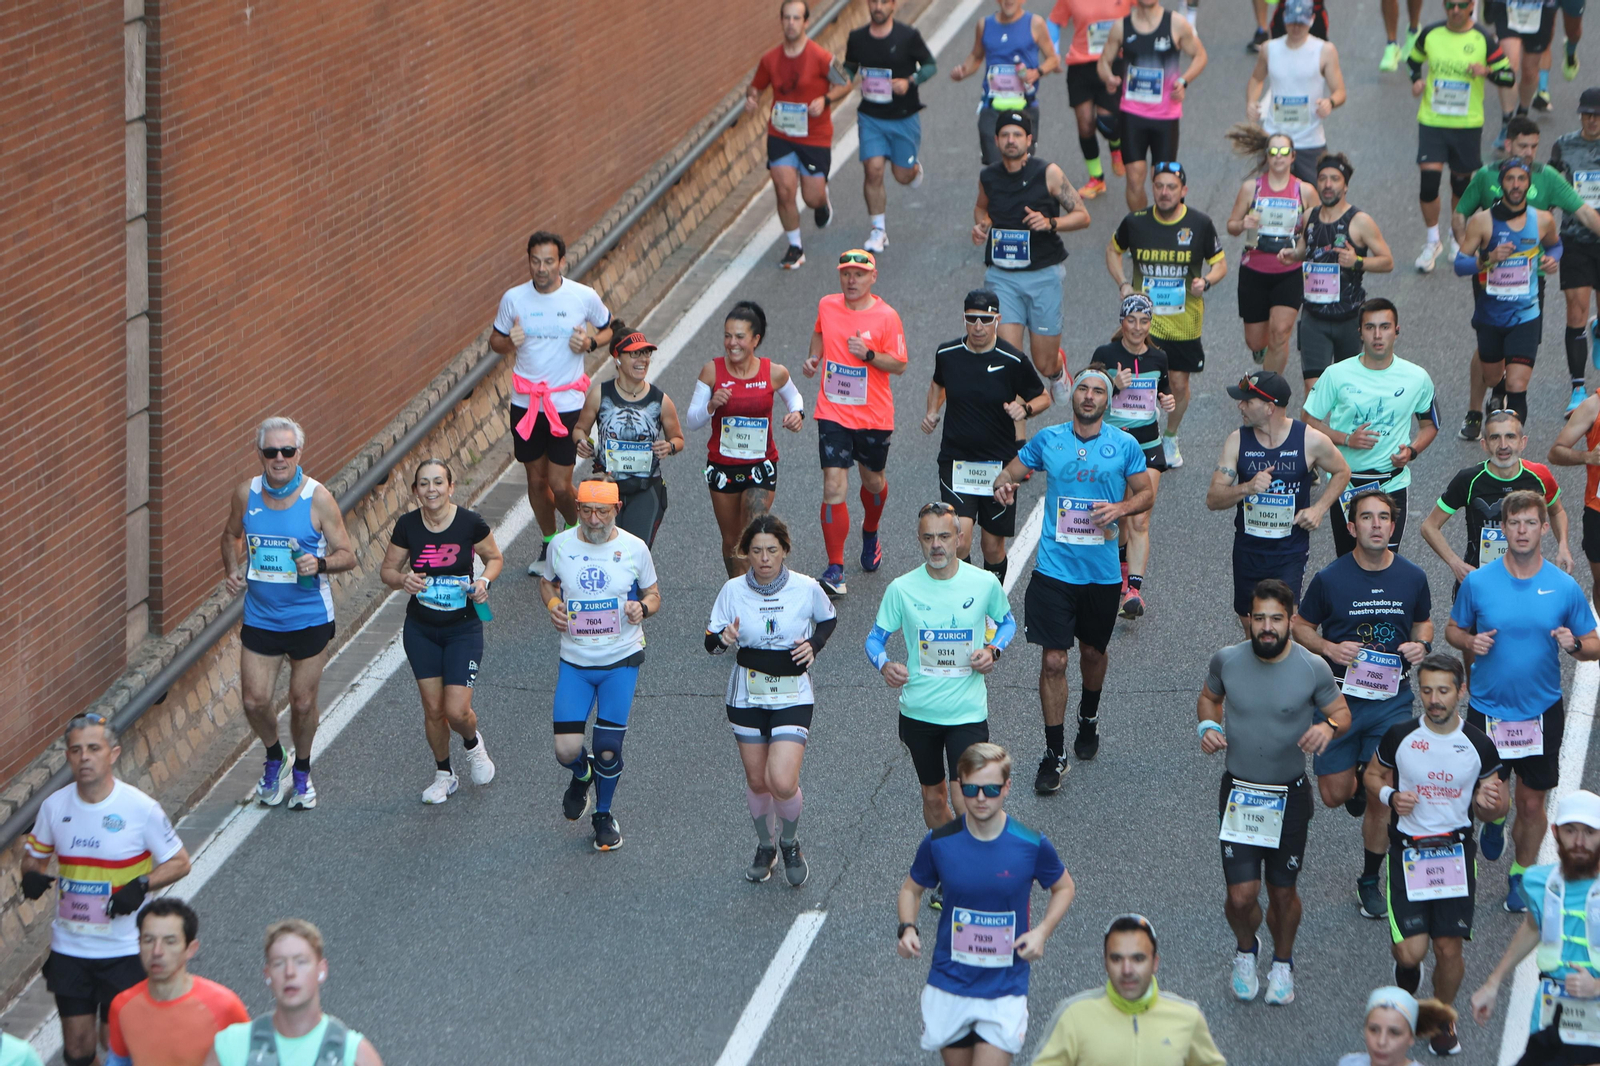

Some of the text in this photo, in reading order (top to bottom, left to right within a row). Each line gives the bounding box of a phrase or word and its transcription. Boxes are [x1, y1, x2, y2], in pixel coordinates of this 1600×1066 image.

[1003, 231, 1025, 240] ZURICH
[1136, 248, 1191, 262] TORRE DE
[1501, 259, 1525, 268] ZURICH
[1139, 264, 1189, 277] LAS ARCAS
[1313, 265, 1334, 273] ZURICH
[1156, 279, 1180, 288] ZURICH
[838, 367, 862, 377] ZURICH
[837, 379, 851, 388] 7460
[1129, 380, 1153, 389] ZURICH
[837, 389, 850, 397] FRED
[1127, 393, 1142, 401] 7051
[737, 419, 763, 428] ZURICH
[621, 442, 650, 451] ZURICH
[968, 468, 988, 478] 10423
[977, 478, 991, 487] LADY
[1261, 496, 1289, 506] ZURICH
[1258, 511, 1278, 520] 10421
[1073, 516, 1091, 526] 8048
[1247, 519, 1268, 528] CRISTOF
[1066, 526, 1097, 535] DEVANNEY
[263, 539, 291, 547] ZURICH
[262, 554, 279, 563] 3851
[260, 564, 284, 573] MARRAS
[584, 601, 613, 610] ZURICH
[1352, 600, 1404, 609] Conectados por
[1349, 609, 1374, 617] nuestro
[586, 617, 603, 626] 7604
[576, 626, 614, 636] MONTÁNCHEZ
[937, 631, 968, 641] ZURICH
[937, 648, 956, 657] 9314
[937, 658, 957, 667] ANGEL
[1370, 654, 1398, 667] ZURICH
[765, 675, 782, 684] 9237
[1366, 669, 1384, 681] 7885
[769, 685, 779, 693] WI
[1355, 678, 1390, 691] DAMASEVIC
[1507, 728, 1524, 738] 7241
[1411, 738, 1430, 752] edp
[1497, 739, 1510, 748] FER
[1427, 770, 1454, 783] edp
[1247, 796, 1279, 808] ZURICH
[1242, 812, 1265, 824] 11158
[1244, 825, 1259, 834] TICO
[70, 835, 101, 850] Jesús
[1424, 847, 1457, 859] ZURICH
[1427, 877, 1446, 887] JOSE
[71, 883, 104, 895] ZURICH
[974, 914, 1009, 926] ZURICH
[973, 932, 994, 943] 7939
[975, 946, 998, 955] TARNO
